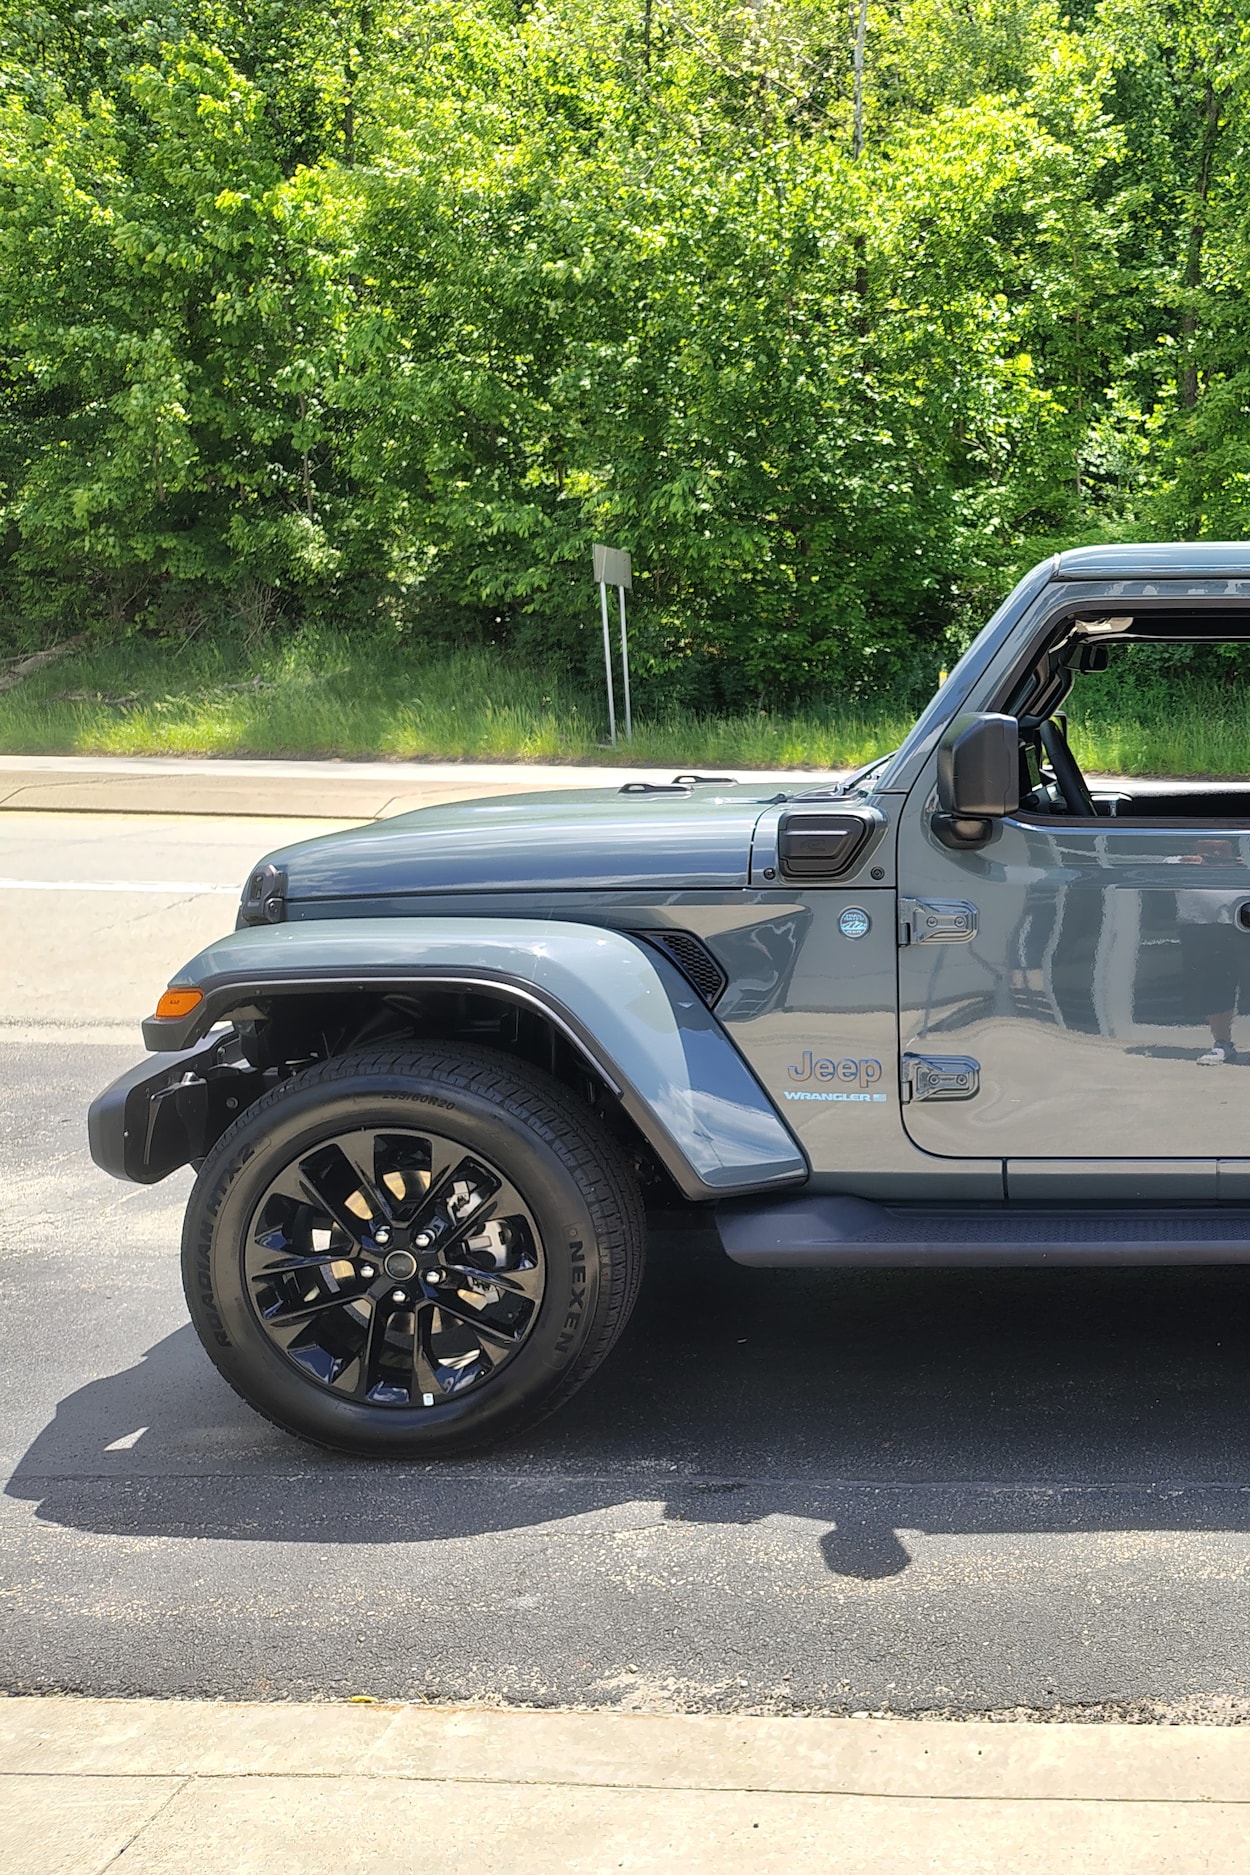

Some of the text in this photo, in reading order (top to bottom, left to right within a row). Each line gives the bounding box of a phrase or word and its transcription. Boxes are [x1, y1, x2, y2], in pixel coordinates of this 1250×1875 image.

[787, 1050, 882, 1088] Jeep
[783, 1091, 871, 1102] WRANGLER
[554, 1240, 586, 1353] NEXEN
